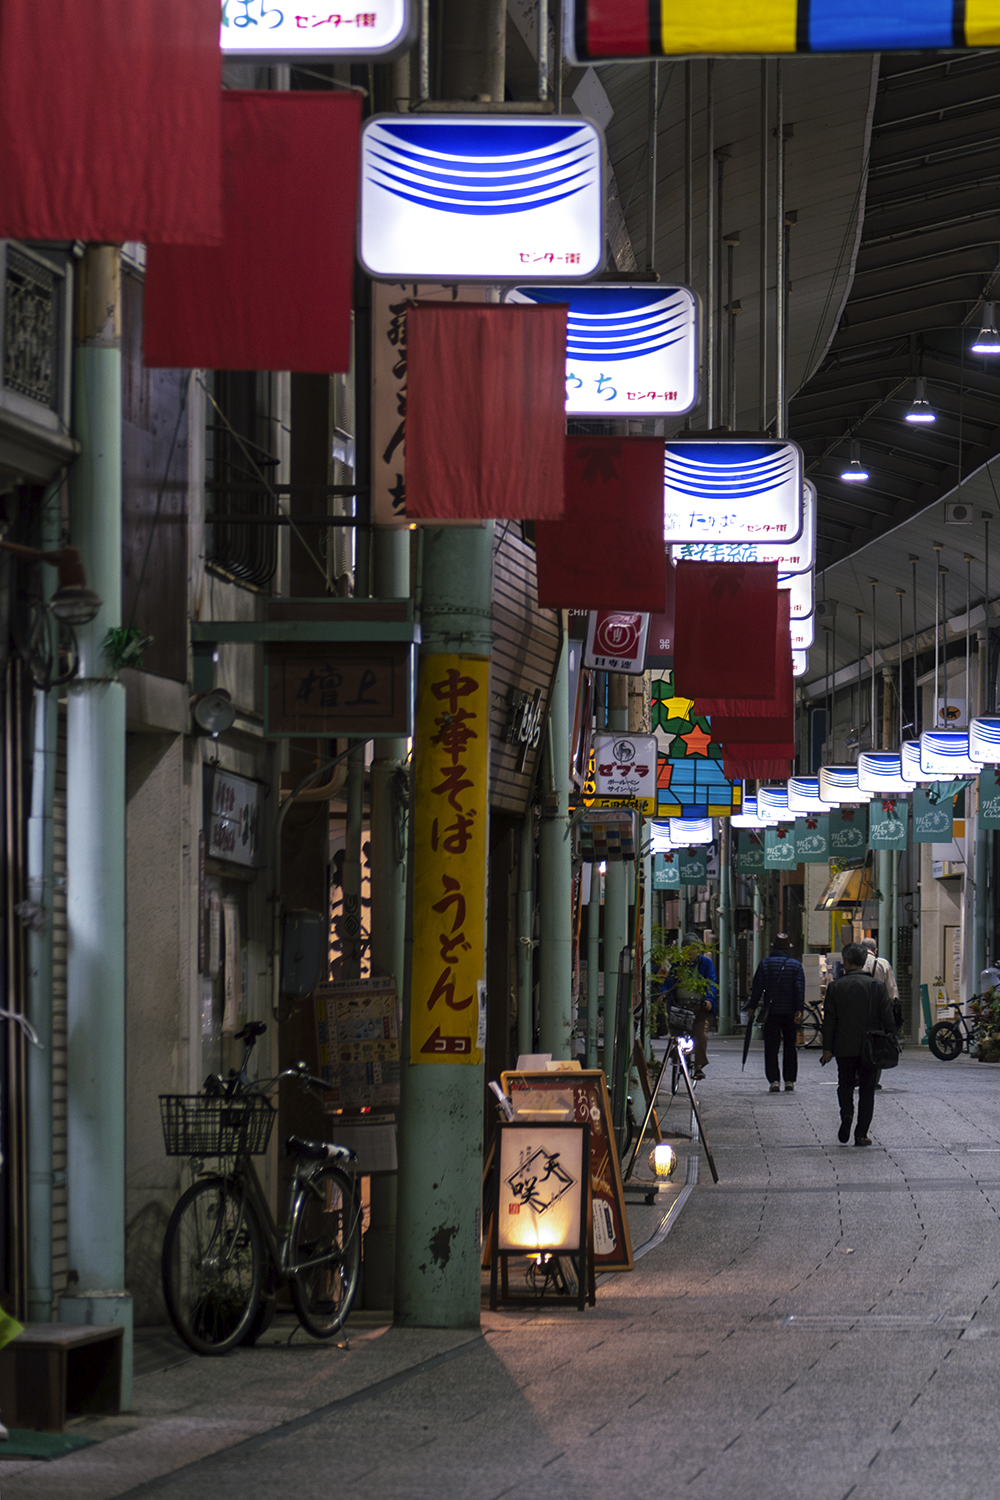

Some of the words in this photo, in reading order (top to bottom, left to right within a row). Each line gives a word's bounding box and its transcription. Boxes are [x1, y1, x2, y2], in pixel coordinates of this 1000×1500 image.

[295, 12, 376, 28] センター街
[518, 252, 581, 264] センター街
[627, 391, 678, 401] センター街
[747, 524, 787, 532] センター街
[430, 668, 480, 855] 中華そば
[598, 761, 649, 777] ゼブラ
[427, 873, 474, 1012] うどん
[434, 1039, 466, 1051] ココ
